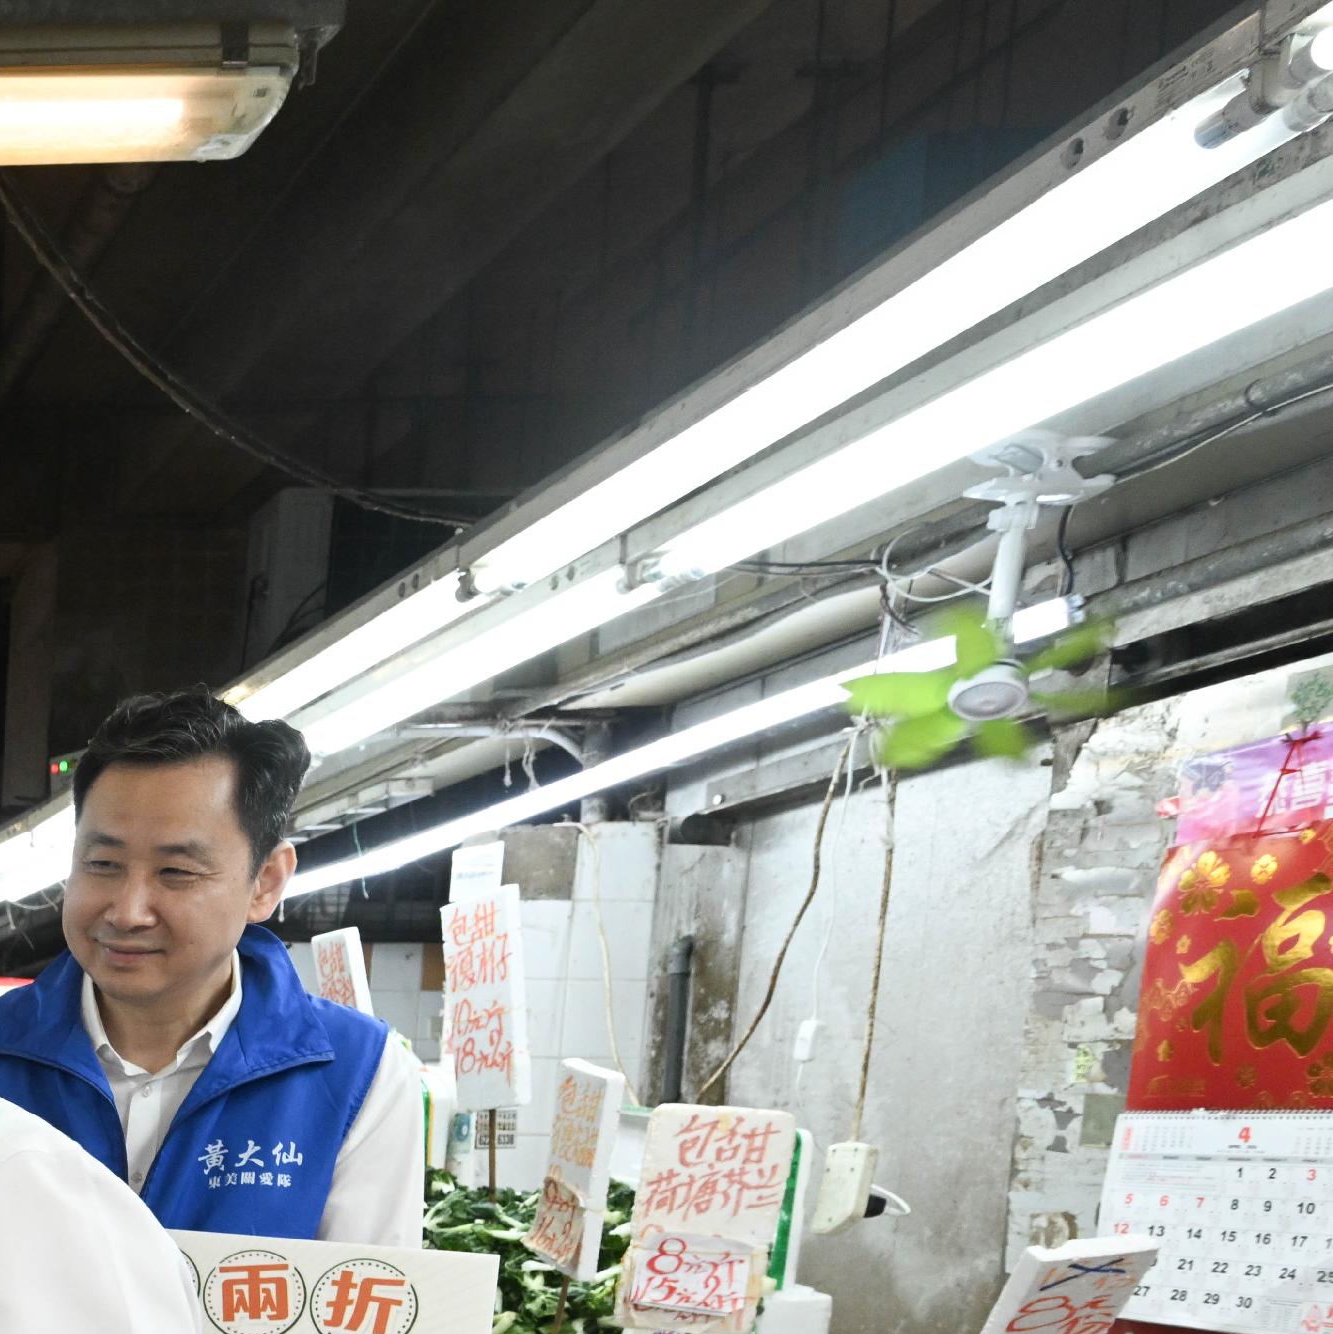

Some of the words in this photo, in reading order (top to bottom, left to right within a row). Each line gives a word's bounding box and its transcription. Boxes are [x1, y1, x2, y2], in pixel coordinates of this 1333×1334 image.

[1238, 1126, 1252, 1143] 4
[197, 1138, 303, 1175] 黃大仙
[1237, 1167, 1244, 1178] 1
[1268, 1168, 1277, 1179] 2
[1307, 1169, 1318, 1181] 3
[1159, 1195, 1169, 1207] 6
[1196, 1197, 1205, 1208] 7
[1230, 1199, 1239, 1210] 8
[1263, 1200, 1272, 1212] 9
[1298, 1203, 1316, 1215] 10
[1113, 1223, 1130, 1235] 12
[1148, 1225, 1166, 1237] 13
[1187, 1229, 1203, 1240] 14
[1221, 1231, 1237, 1242] 15
[1254, 1233, 1272, 1245] 16
[1290, 1235, 1309, 1247] 17
[1177, 1259, 1194, 1271] 21
[1212, 1261, 1229, 1274] 22
[1244, 1265, 1262, 1277] 23
[1278, 1268, 1297, 1280] 24
[1170, 1289, 1188, 1301] 28
[1203, 1293, 1220, 1305] 29
[1236, 1296, 1253, 1309] 30
